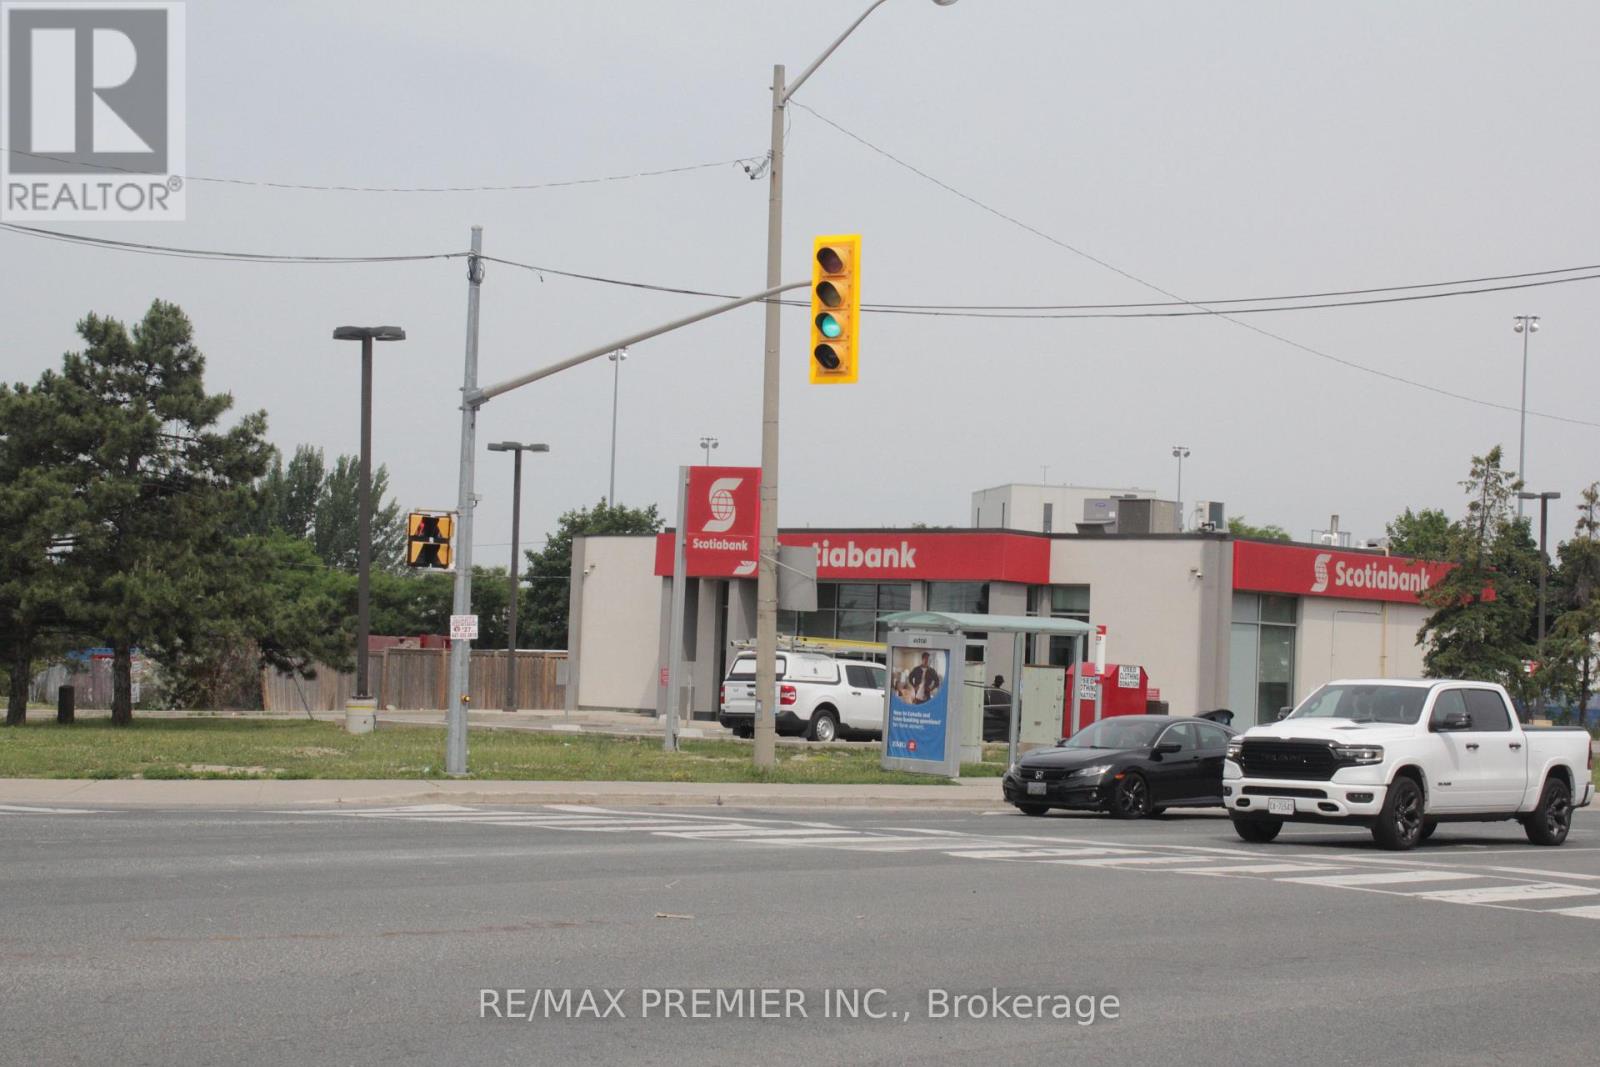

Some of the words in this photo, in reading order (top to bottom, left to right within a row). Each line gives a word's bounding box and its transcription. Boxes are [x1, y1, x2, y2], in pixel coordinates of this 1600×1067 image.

[692, 538, 748, 551] Scotiabank
[812, 539, 917, 568] tiabank
[1335, 560, 1430, 592] Scotiabank
